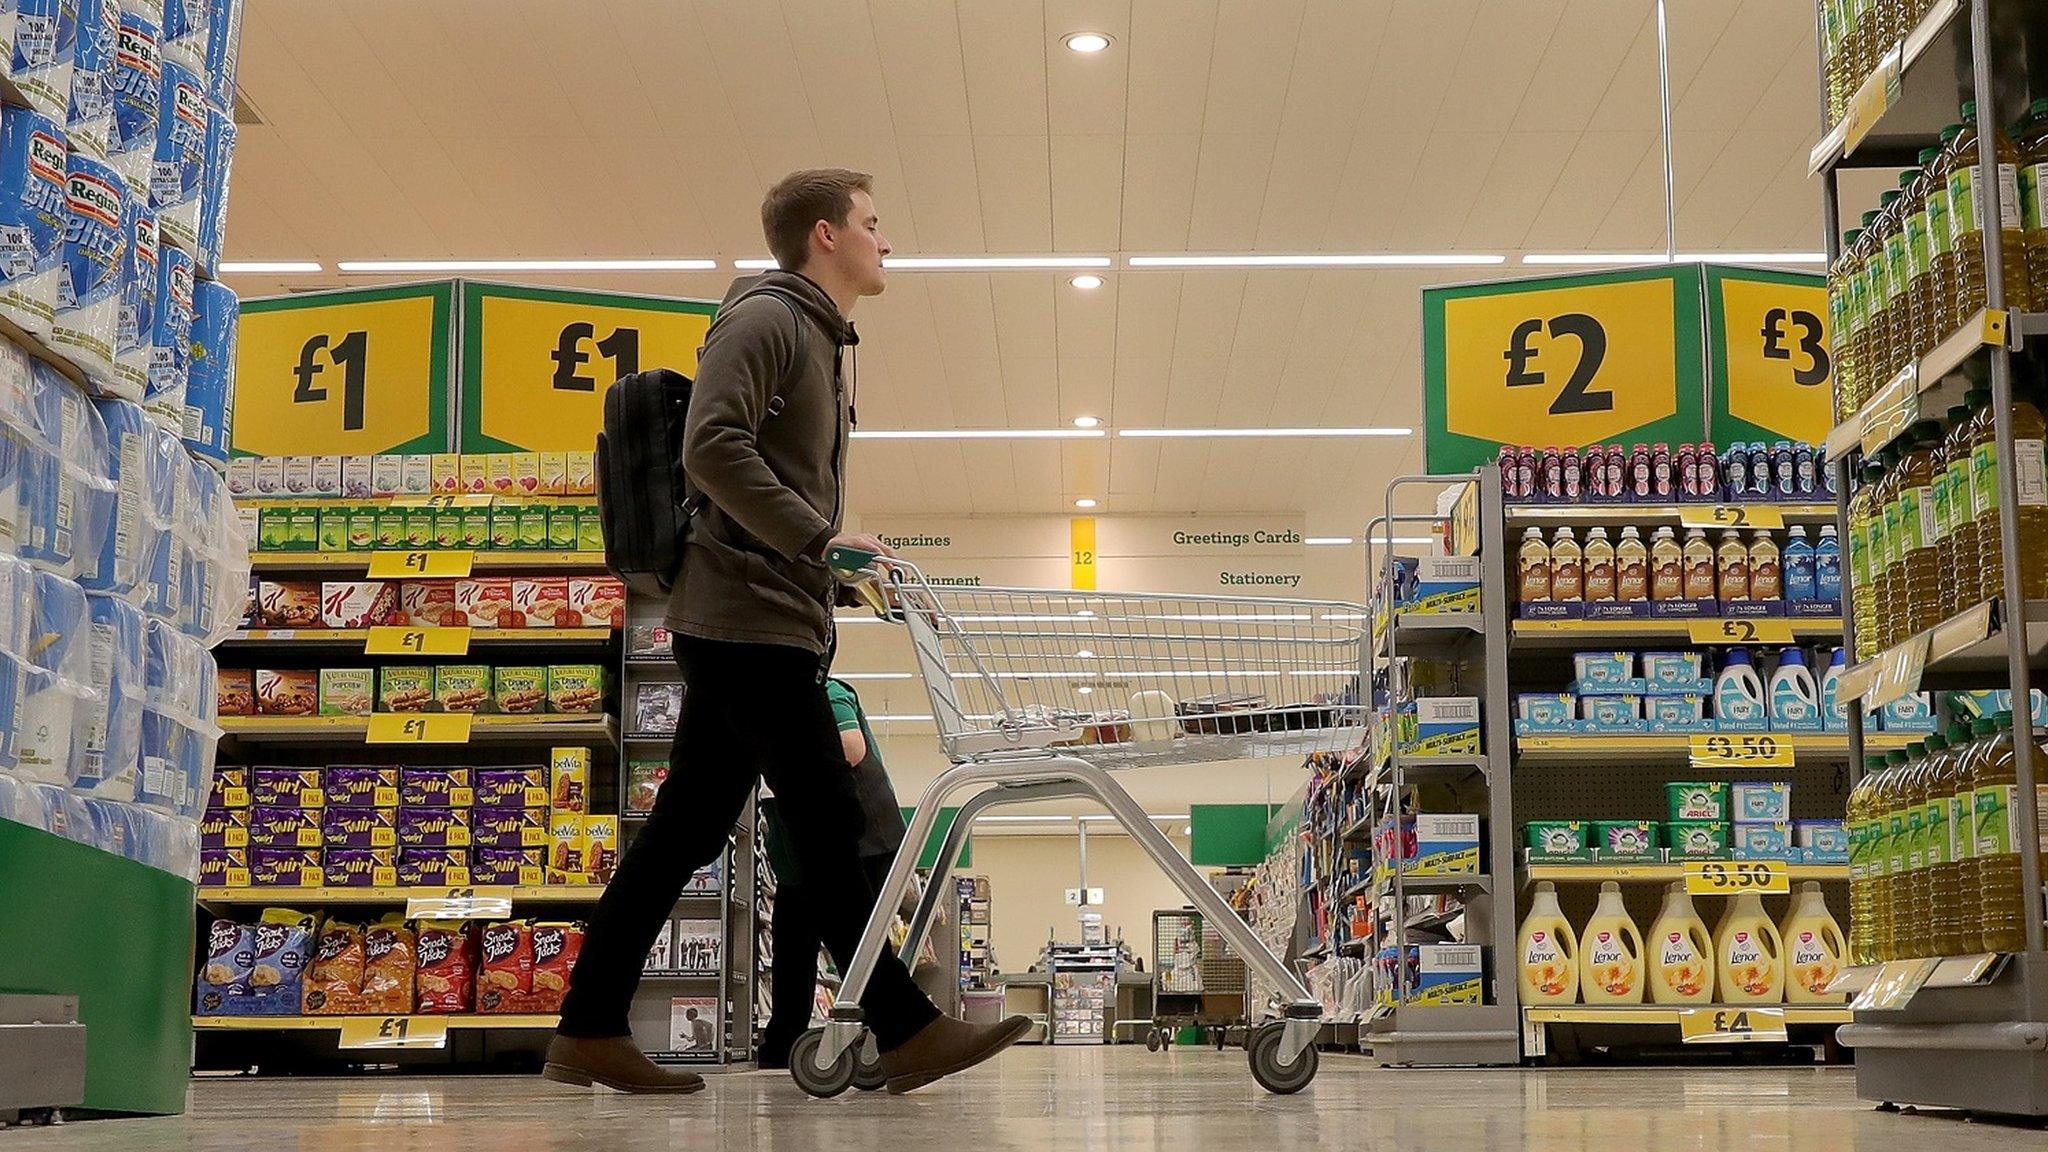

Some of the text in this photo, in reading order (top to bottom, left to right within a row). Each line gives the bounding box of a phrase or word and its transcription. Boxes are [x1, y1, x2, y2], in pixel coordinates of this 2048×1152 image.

[1760, 307, 1831, 387] £3
[1503, 312, 1614, 416] £2
[293, 331, 369, 432] £1
[1713, 506, 1750, 527] £2
[1173, 529, 1300, 547] Greetings Cards
[405, 553, 428, 572] £1
[1074, 551, 1093, 565] 12
[1220, 571, 1301, 588] Stationery
[1789, 575, 1812, 586] Lenor
[264, 587, 286, 612] K
[325, 585, 356, 618] K
[405, 586, 426, 609] K
[459, 584, 480, 606] K
[517, 583, 537, 606] K
[573, 583, 593, 605] K
[1722, 620, 1760, 642] £2
[402, 632, 425, 652] £1
[260, 676, 283, 700] K
[403, 719, 426, 741] £1
[1707, 736, 1777, 759] £3.50
[1702, 863, 1772, 888] £3.50
[484, 929, 515, 948] Snack
[534, 930, 562, 948] Snack
[487, 943, 514, 963] Jacks
[535, 944, 562, 964] Jacks
[1528, 950, 1556, 964] Lenor
[1594, 950, 1621, 964] Lenor
[1664, 951, 1692, 965] Lenor
[1731, 951, 1760, 964] Lenor
[1796, 950, 1824, 964] Lenor
[379, 1018, 409, 1046] £1
[1713, 1010, 1753, 1041] £4
